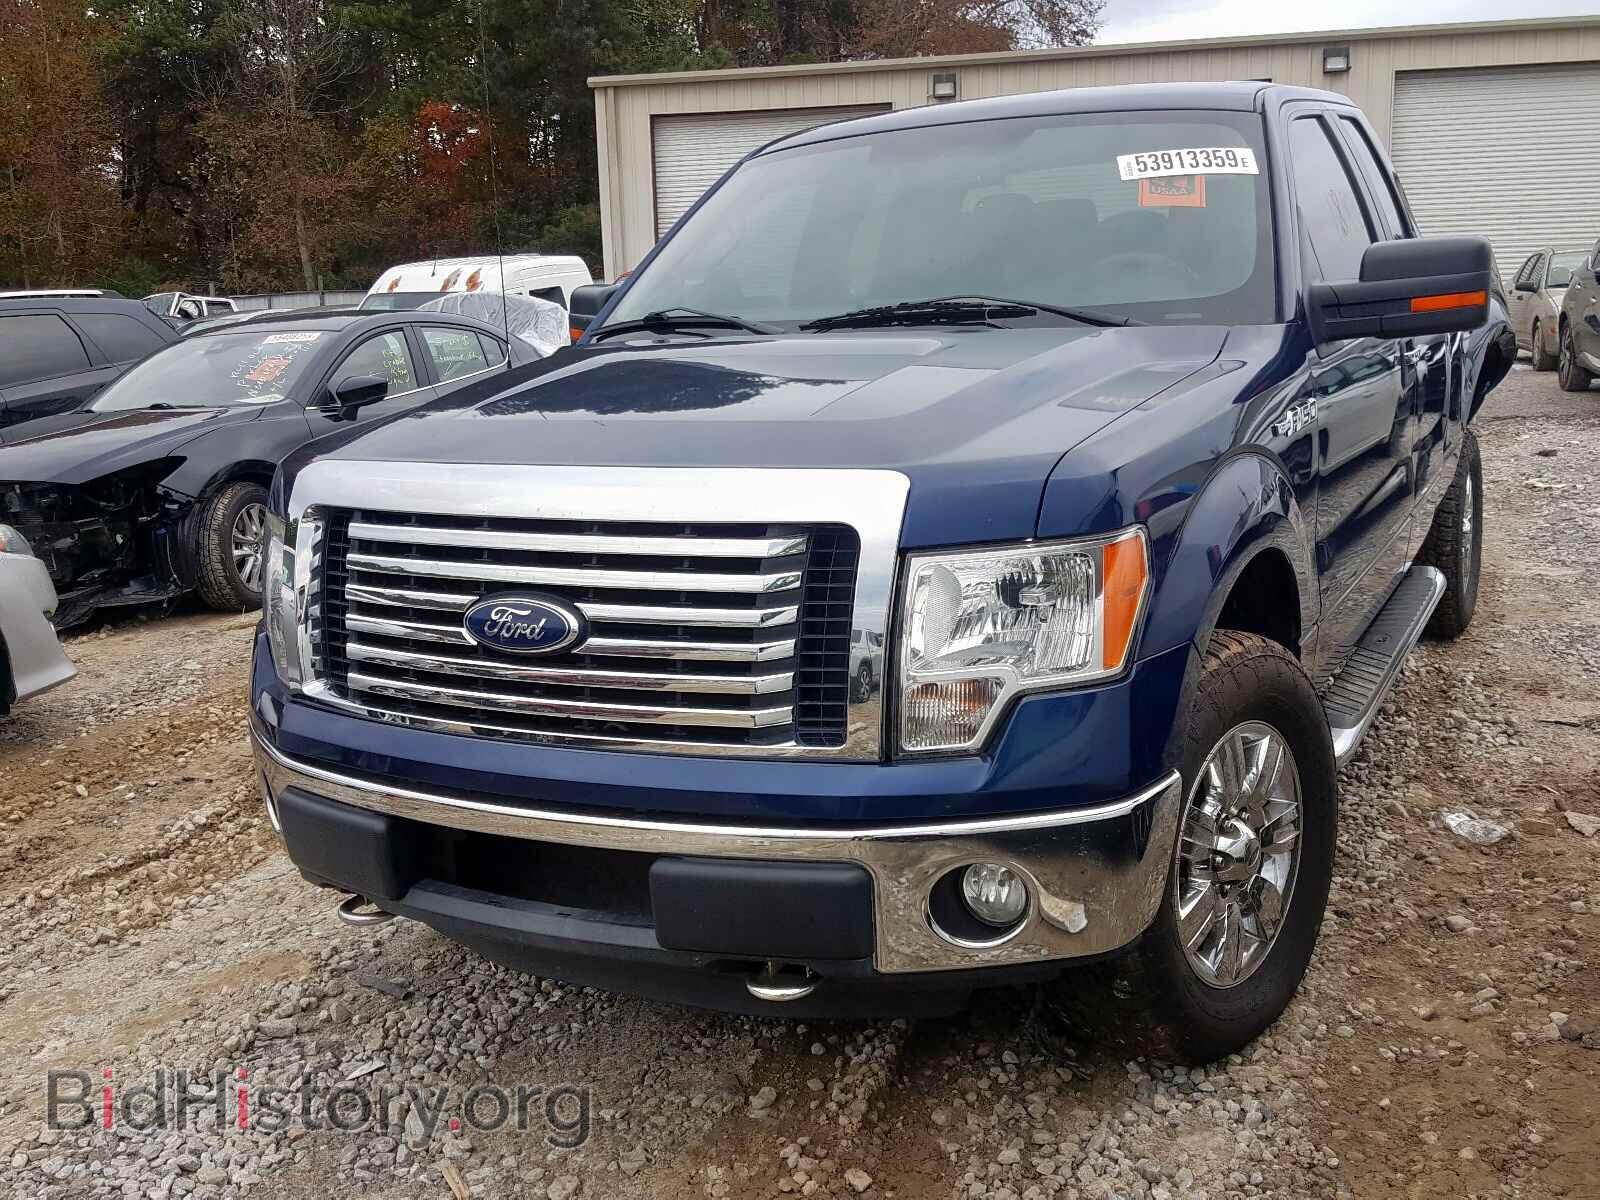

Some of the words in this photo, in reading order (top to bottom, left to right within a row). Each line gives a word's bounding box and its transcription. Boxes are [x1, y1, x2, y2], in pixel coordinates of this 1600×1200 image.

[1134, 149, 1239, 173] 53913359
[1240, 157, 1249, 168] E
[484, 606, 547, 640] Ford
